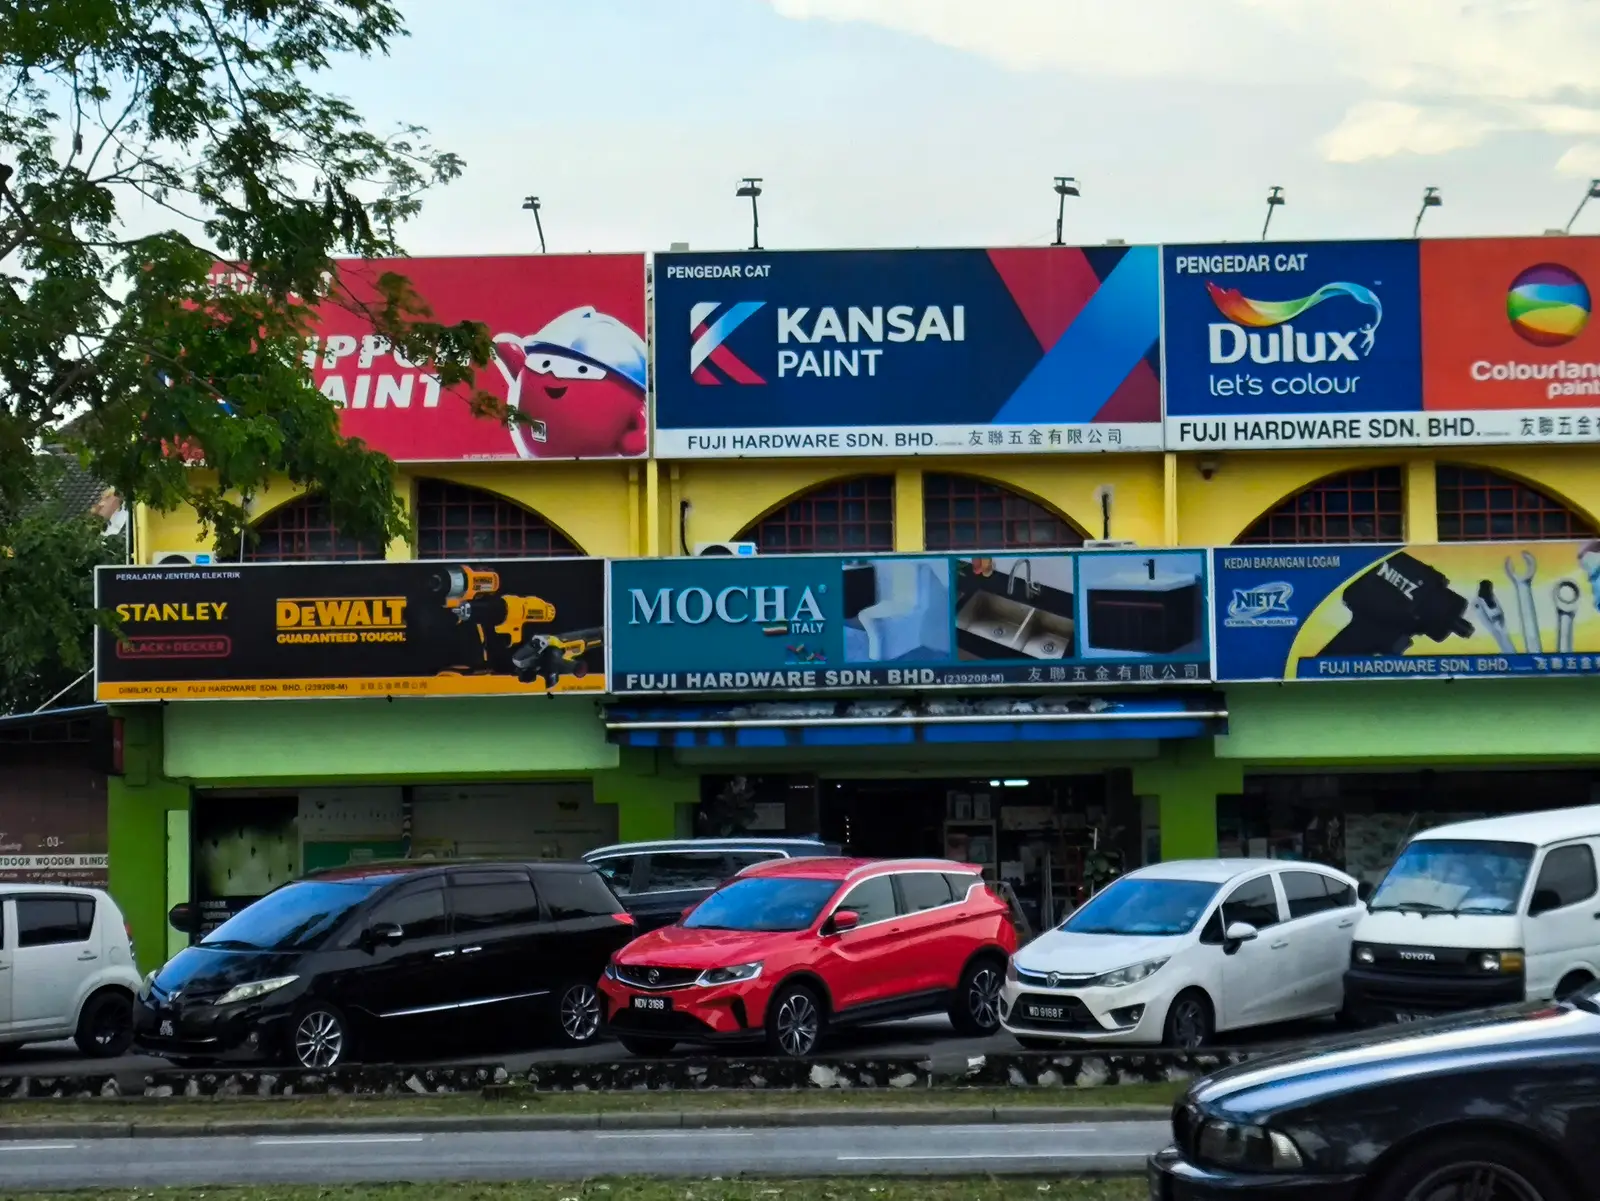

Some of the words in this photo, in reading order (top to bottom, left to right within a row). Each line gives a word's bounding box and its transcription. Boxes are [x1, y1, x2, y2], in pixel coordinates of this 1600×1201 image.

[666, 265, 742, 279] PENGEDAR
[744, 264, 772, 278] CAT
[1176, 254, 1270, 274] PENGEDAR
[1274, 253, 1309, 272] CAT
[777, 305, 965, 344] KANSAI
[1208, 322, 1360, 364] Dulux
[777, 349, 884, 378] PAINT
[1470, 360, 1600, 381] Colourlan
[298, 373, 442, 409] AINT
[1210, 374, 1264, 396] let's
[1271, 372, 1361, 395] colour
[1179, 421, 1227, 442] FUJI
[1233, 418, 1361, 441] HARDWARE
[1368, 418, 1421, 439] SDN.
[1428, 417, 1481, 437] BHD.
[687, 435, 726, 450] FUJI
[732, 433, 840, 449] HARDWARE
[846, 433, 889, 447] SDN.
[894, 432, 938, 447] BHD.
[1224, 557, 1252, 569] KEDAI
[1254, 556, 1305, 569] BARANGAN
[1307, 556, 1340, 568] LOGAM
[115, 573, 163, 581] PERALATAN
[164, 572, 200, 580] JENTERA
[201, 571, 241, 580] ELEKTRIK
[1376, 560, 1419, 600] NIETZ
[628, 585, 826, 625] MOCHA
[1234, 588, 1289, 611] NIETZ
[115, 602, 228, 622] STANLEY
[276, 632, 358, 644] GUARANTEED
[360, 631, 407, 642] TOUGH.
[791, 622, 824, 634] ITALY
[1319, 660, 1350, 674] FUJI
[1353, 659, 1436, 673] HARDWARE
[1440, 658, 1474, 672] SDN.
[1477, 657, 1512, 671] BHD.
[187, 685, 206, 693] FUJI
[208, 684, 257, 692] HARDWARE
[626, 673, 677, 689] FUJI
[686, 671, 817, 688] HARDWARE
[825, 669, 879, 686] SDN.
[887, 668, 941, 685] BHD.
[35, 856, 75, 866] WOODEN
[1400, 952, 1435, 961] TOYOTA
